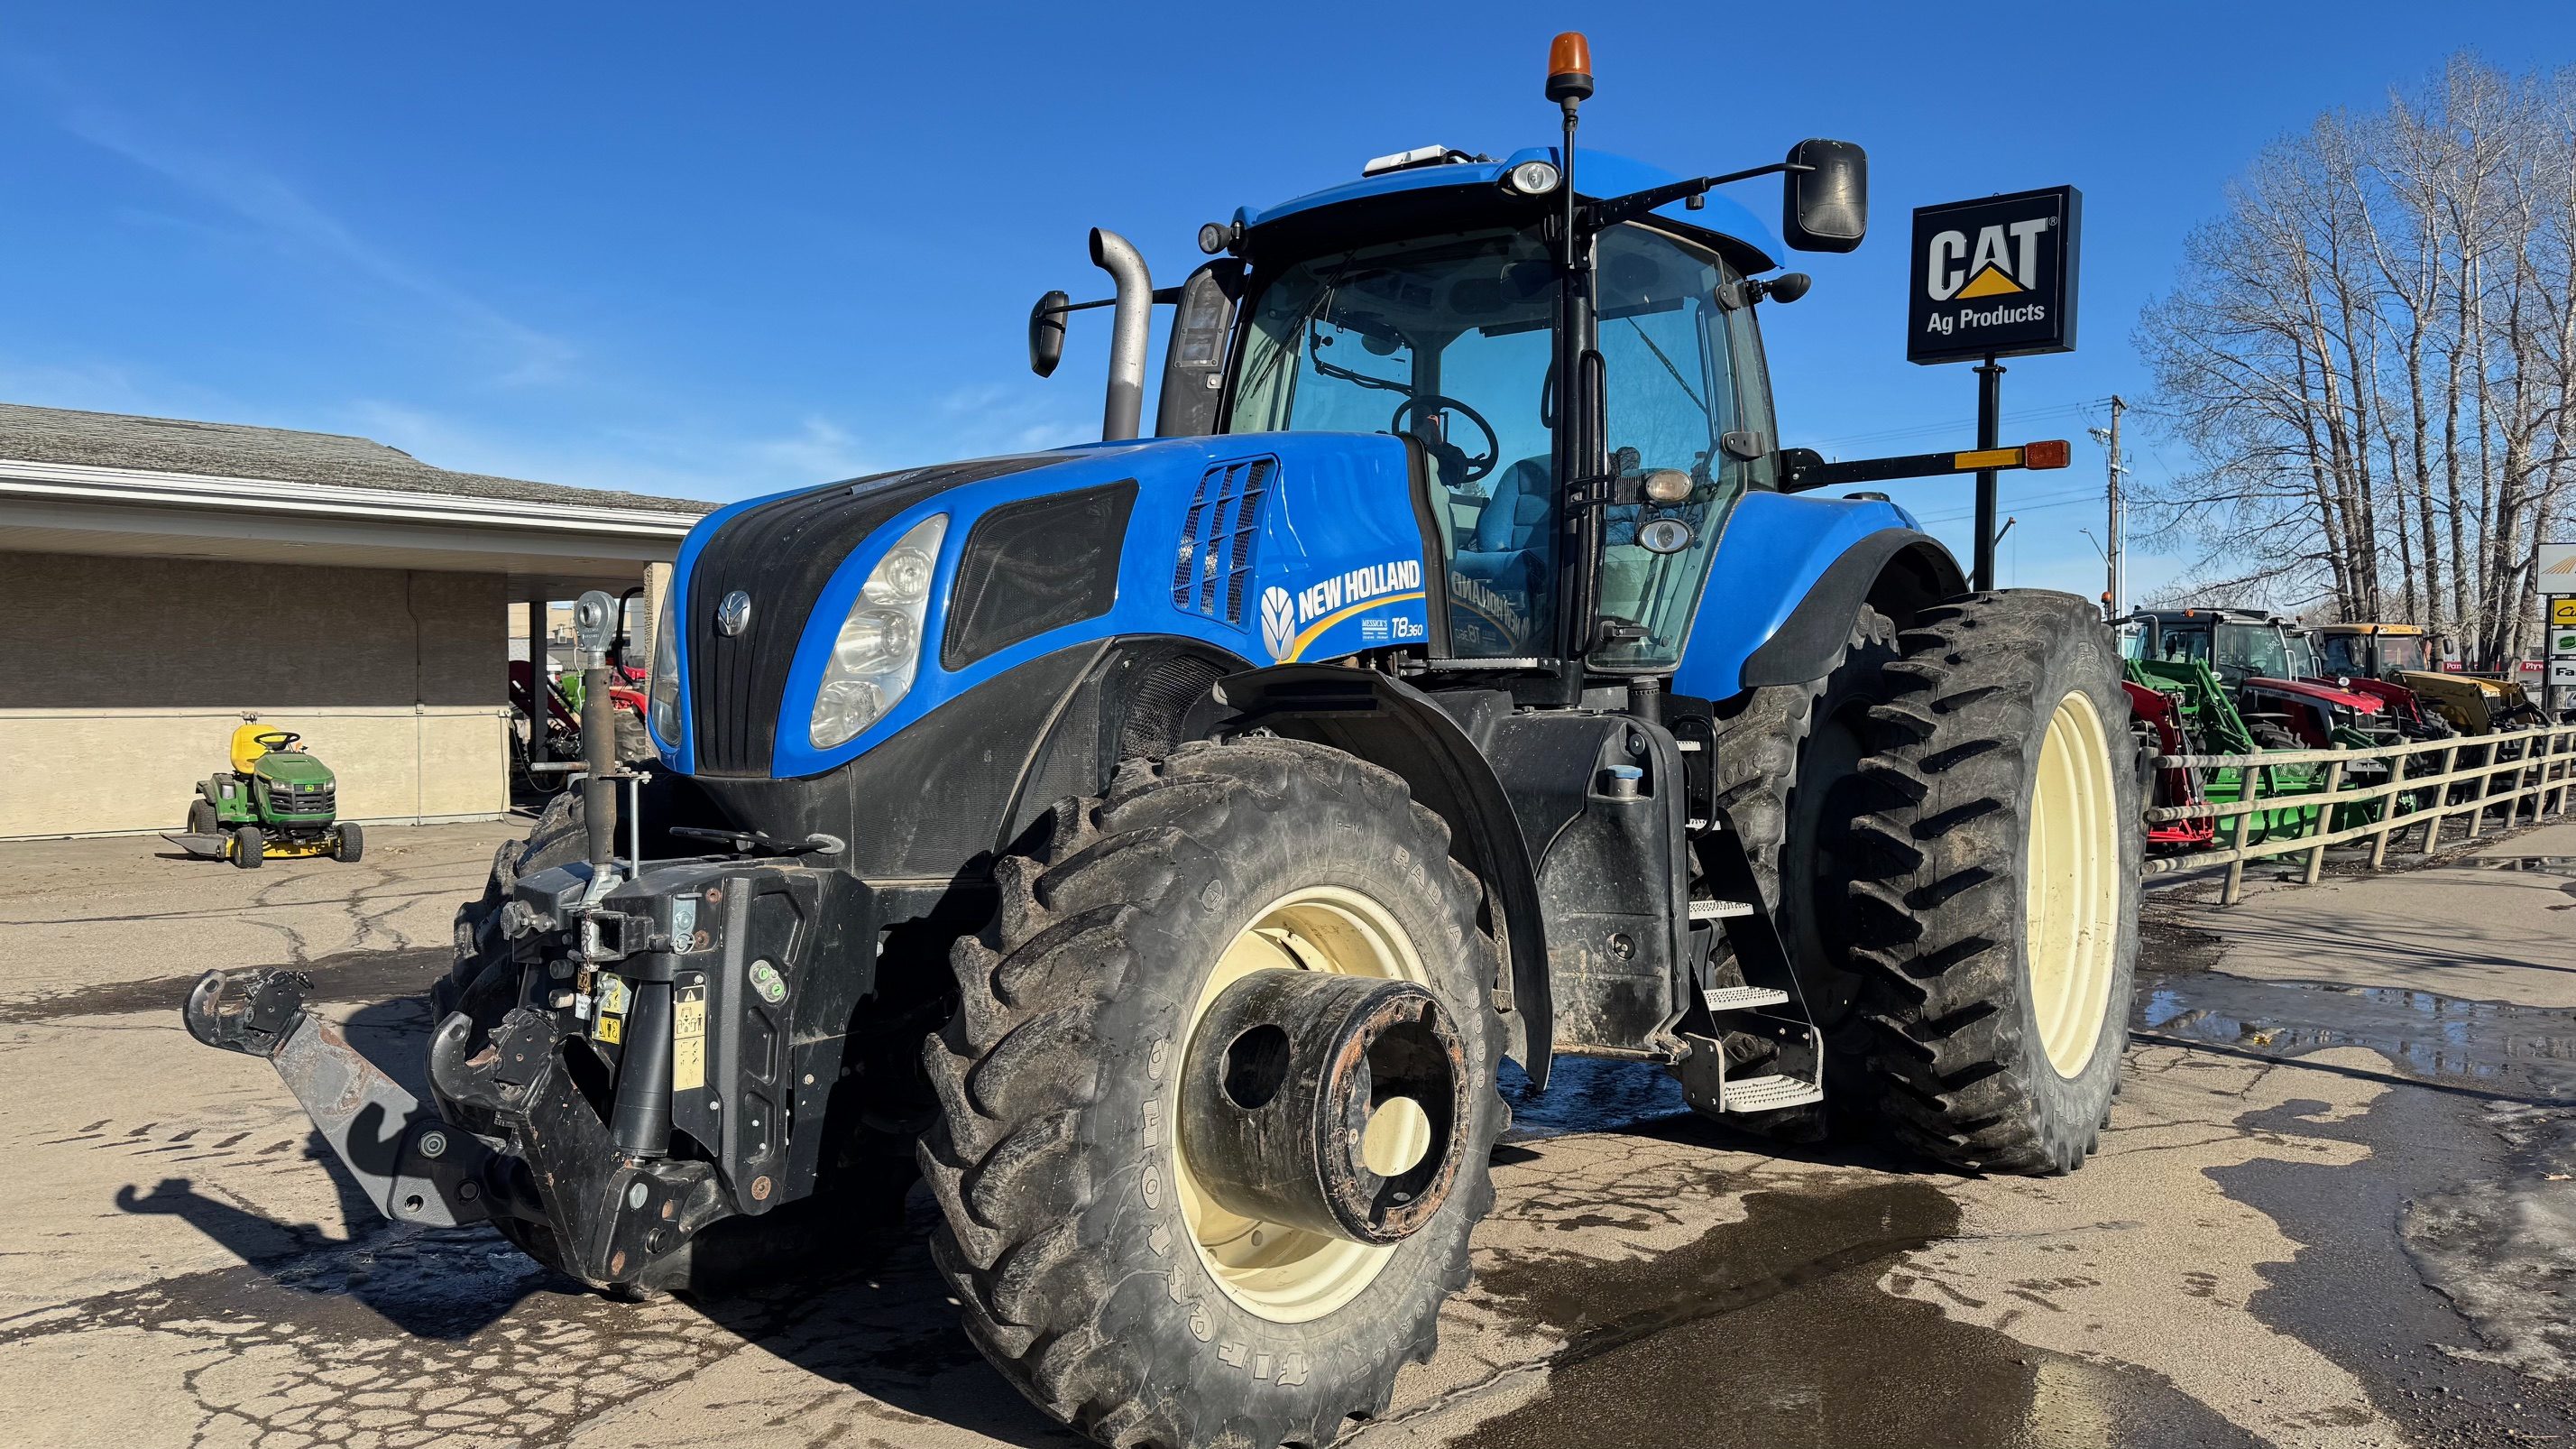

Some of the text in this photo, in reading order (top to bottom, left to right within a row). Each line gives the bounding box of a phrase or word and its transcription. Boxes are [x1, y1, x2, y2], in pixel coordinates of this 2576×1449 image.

[1927, 217, 2048, 301] CAT
[1927, 303, 2045, 336] Ag Products
[1299, 559, 1421, 623] NEW HOLLAND
